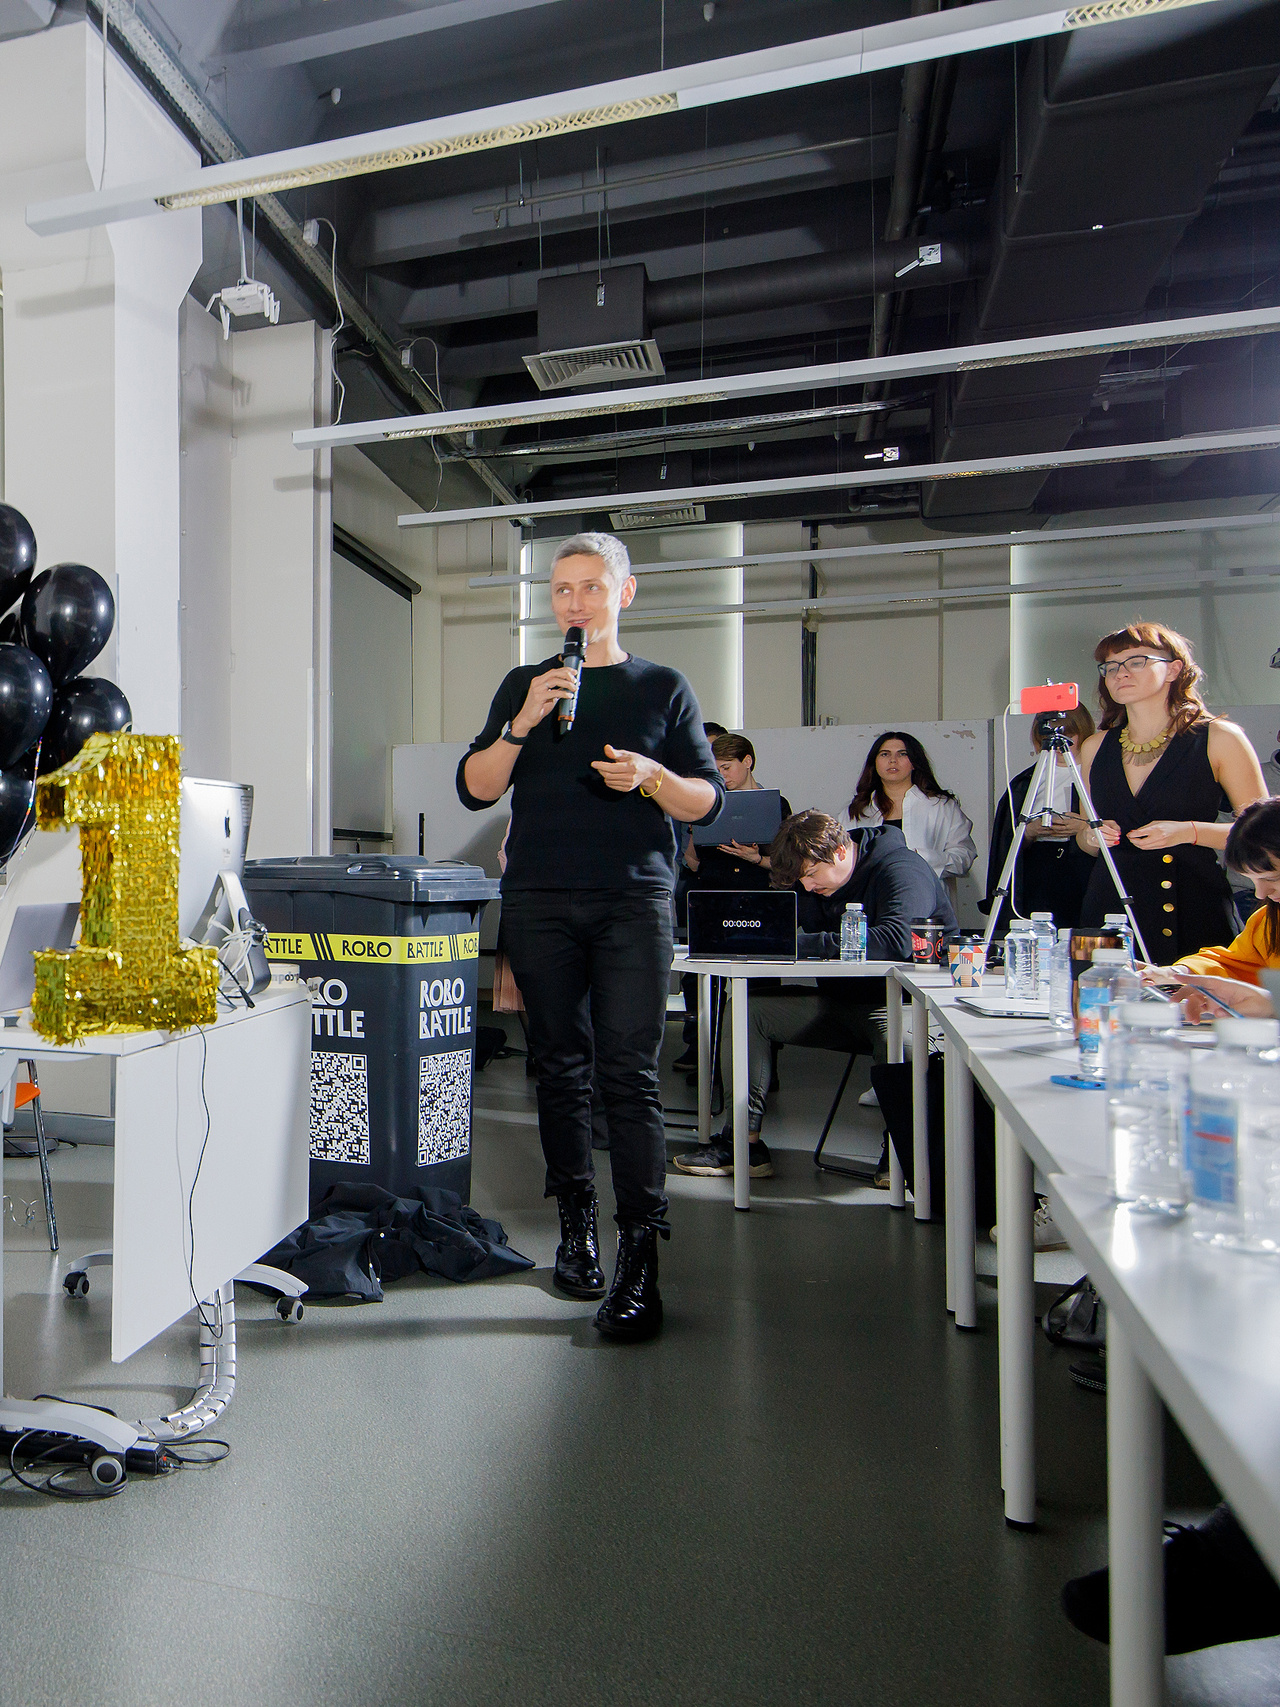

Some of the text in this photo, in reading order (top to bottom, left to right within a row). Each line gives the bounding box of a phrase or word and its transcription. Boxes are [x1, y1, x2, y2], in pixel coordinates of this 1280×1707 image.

[722, 920, 762, 928] 00:00:00
[263, 938, 303, 955] ATTLE
[342, 940, 392, 958] ROBO
[407, 941, 444, 959] BATTLE
[419, 977, 465, 1008] ROBO
[312, 1008, 365, 1039] TTLE
[419, 1005, 472, 1039] BATTLE
